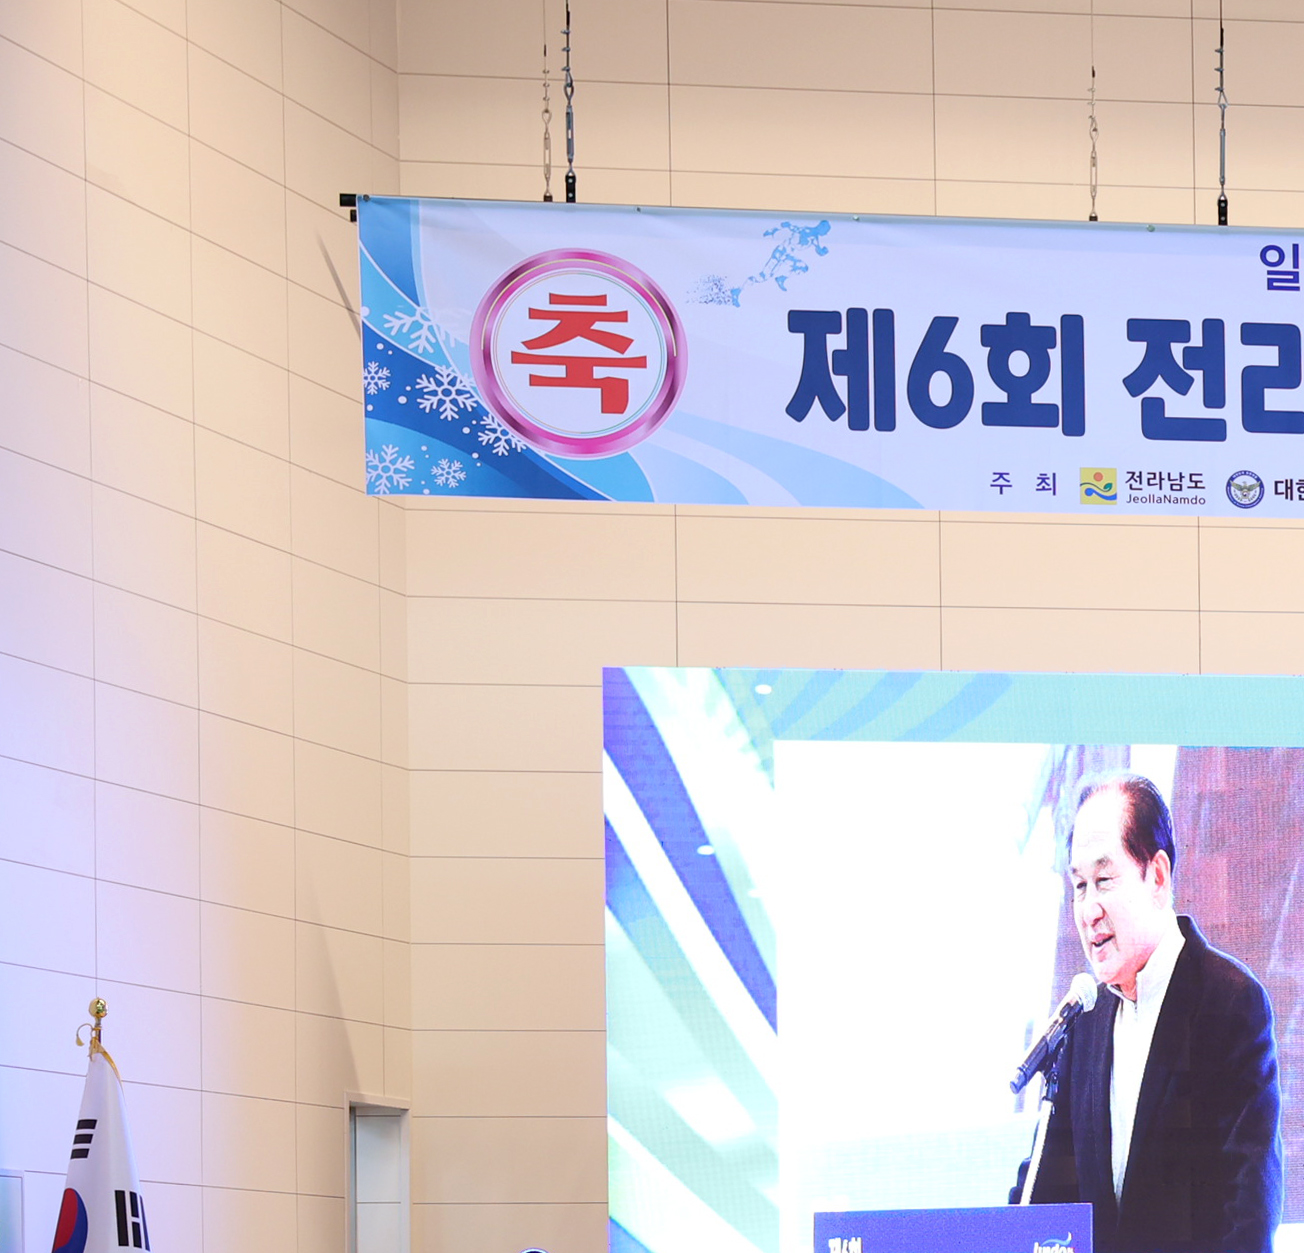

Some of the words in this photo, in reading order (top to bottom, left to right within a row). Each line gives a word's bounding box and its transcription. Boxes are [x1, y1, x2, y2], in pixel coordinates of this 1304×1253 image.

[1259, 243, 1301, 292] 일
[511, 292, 647, 415] 축
[785, 307, 1086, 437] 제6회
[989, 471, 1013, 496] 주
[1035, 472, 1057, 496] 최
[1125, 470, 1206, 492] 전라남도
[1126, 493, 1206, 505] JeollaNamdo
